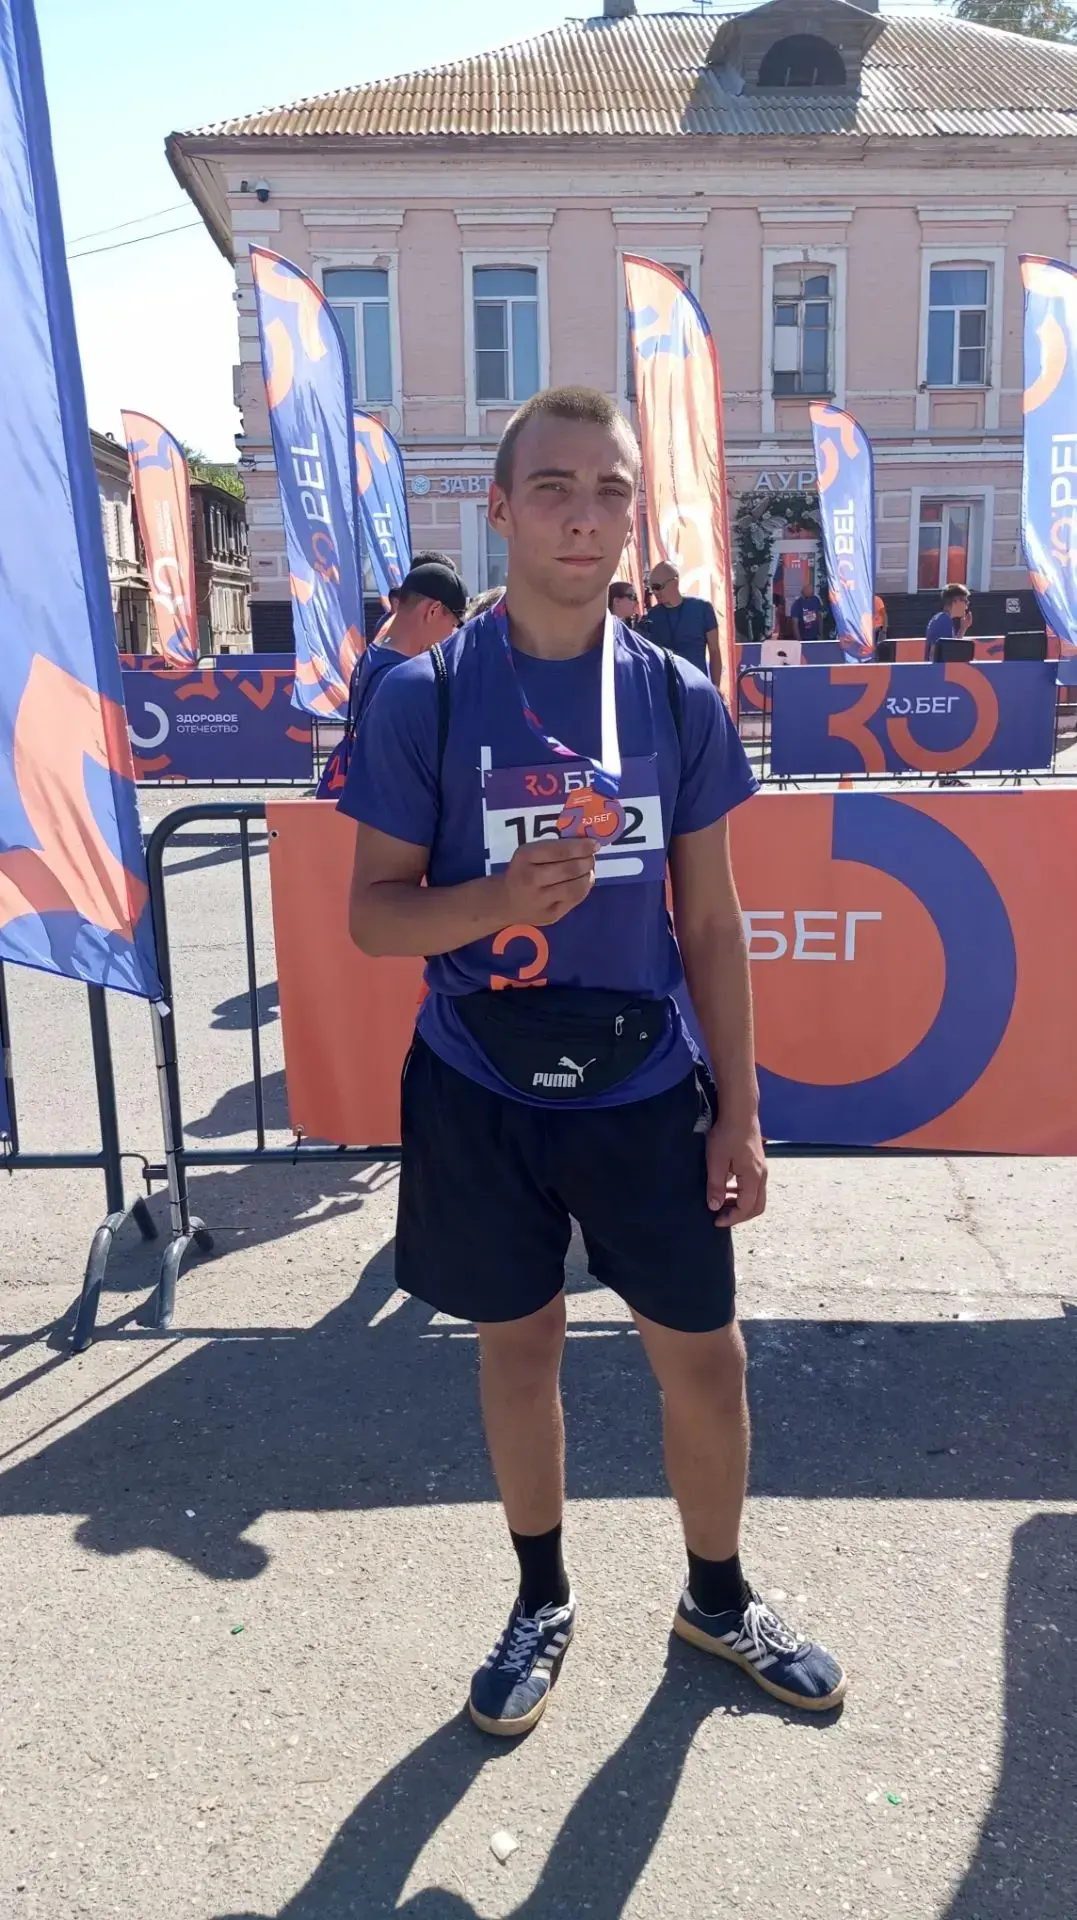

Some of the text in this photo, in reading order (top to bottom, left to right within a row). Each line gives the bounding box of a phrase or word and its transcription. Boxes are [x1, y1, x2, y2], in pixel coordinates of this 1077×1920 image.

[440, 475, 494, 493] ЗАВТ
[754, 470, 817, 491] АУР
[176, 713, 238, 723] ЗДОРОВОЕ
[176, 724, 239, 734] ОТЕЧЕСТВО
[505, 806, 646, 846] 152
[744, 911, 882, 961] БЕГ
[532, 1073, 576, 1088] PUMA
